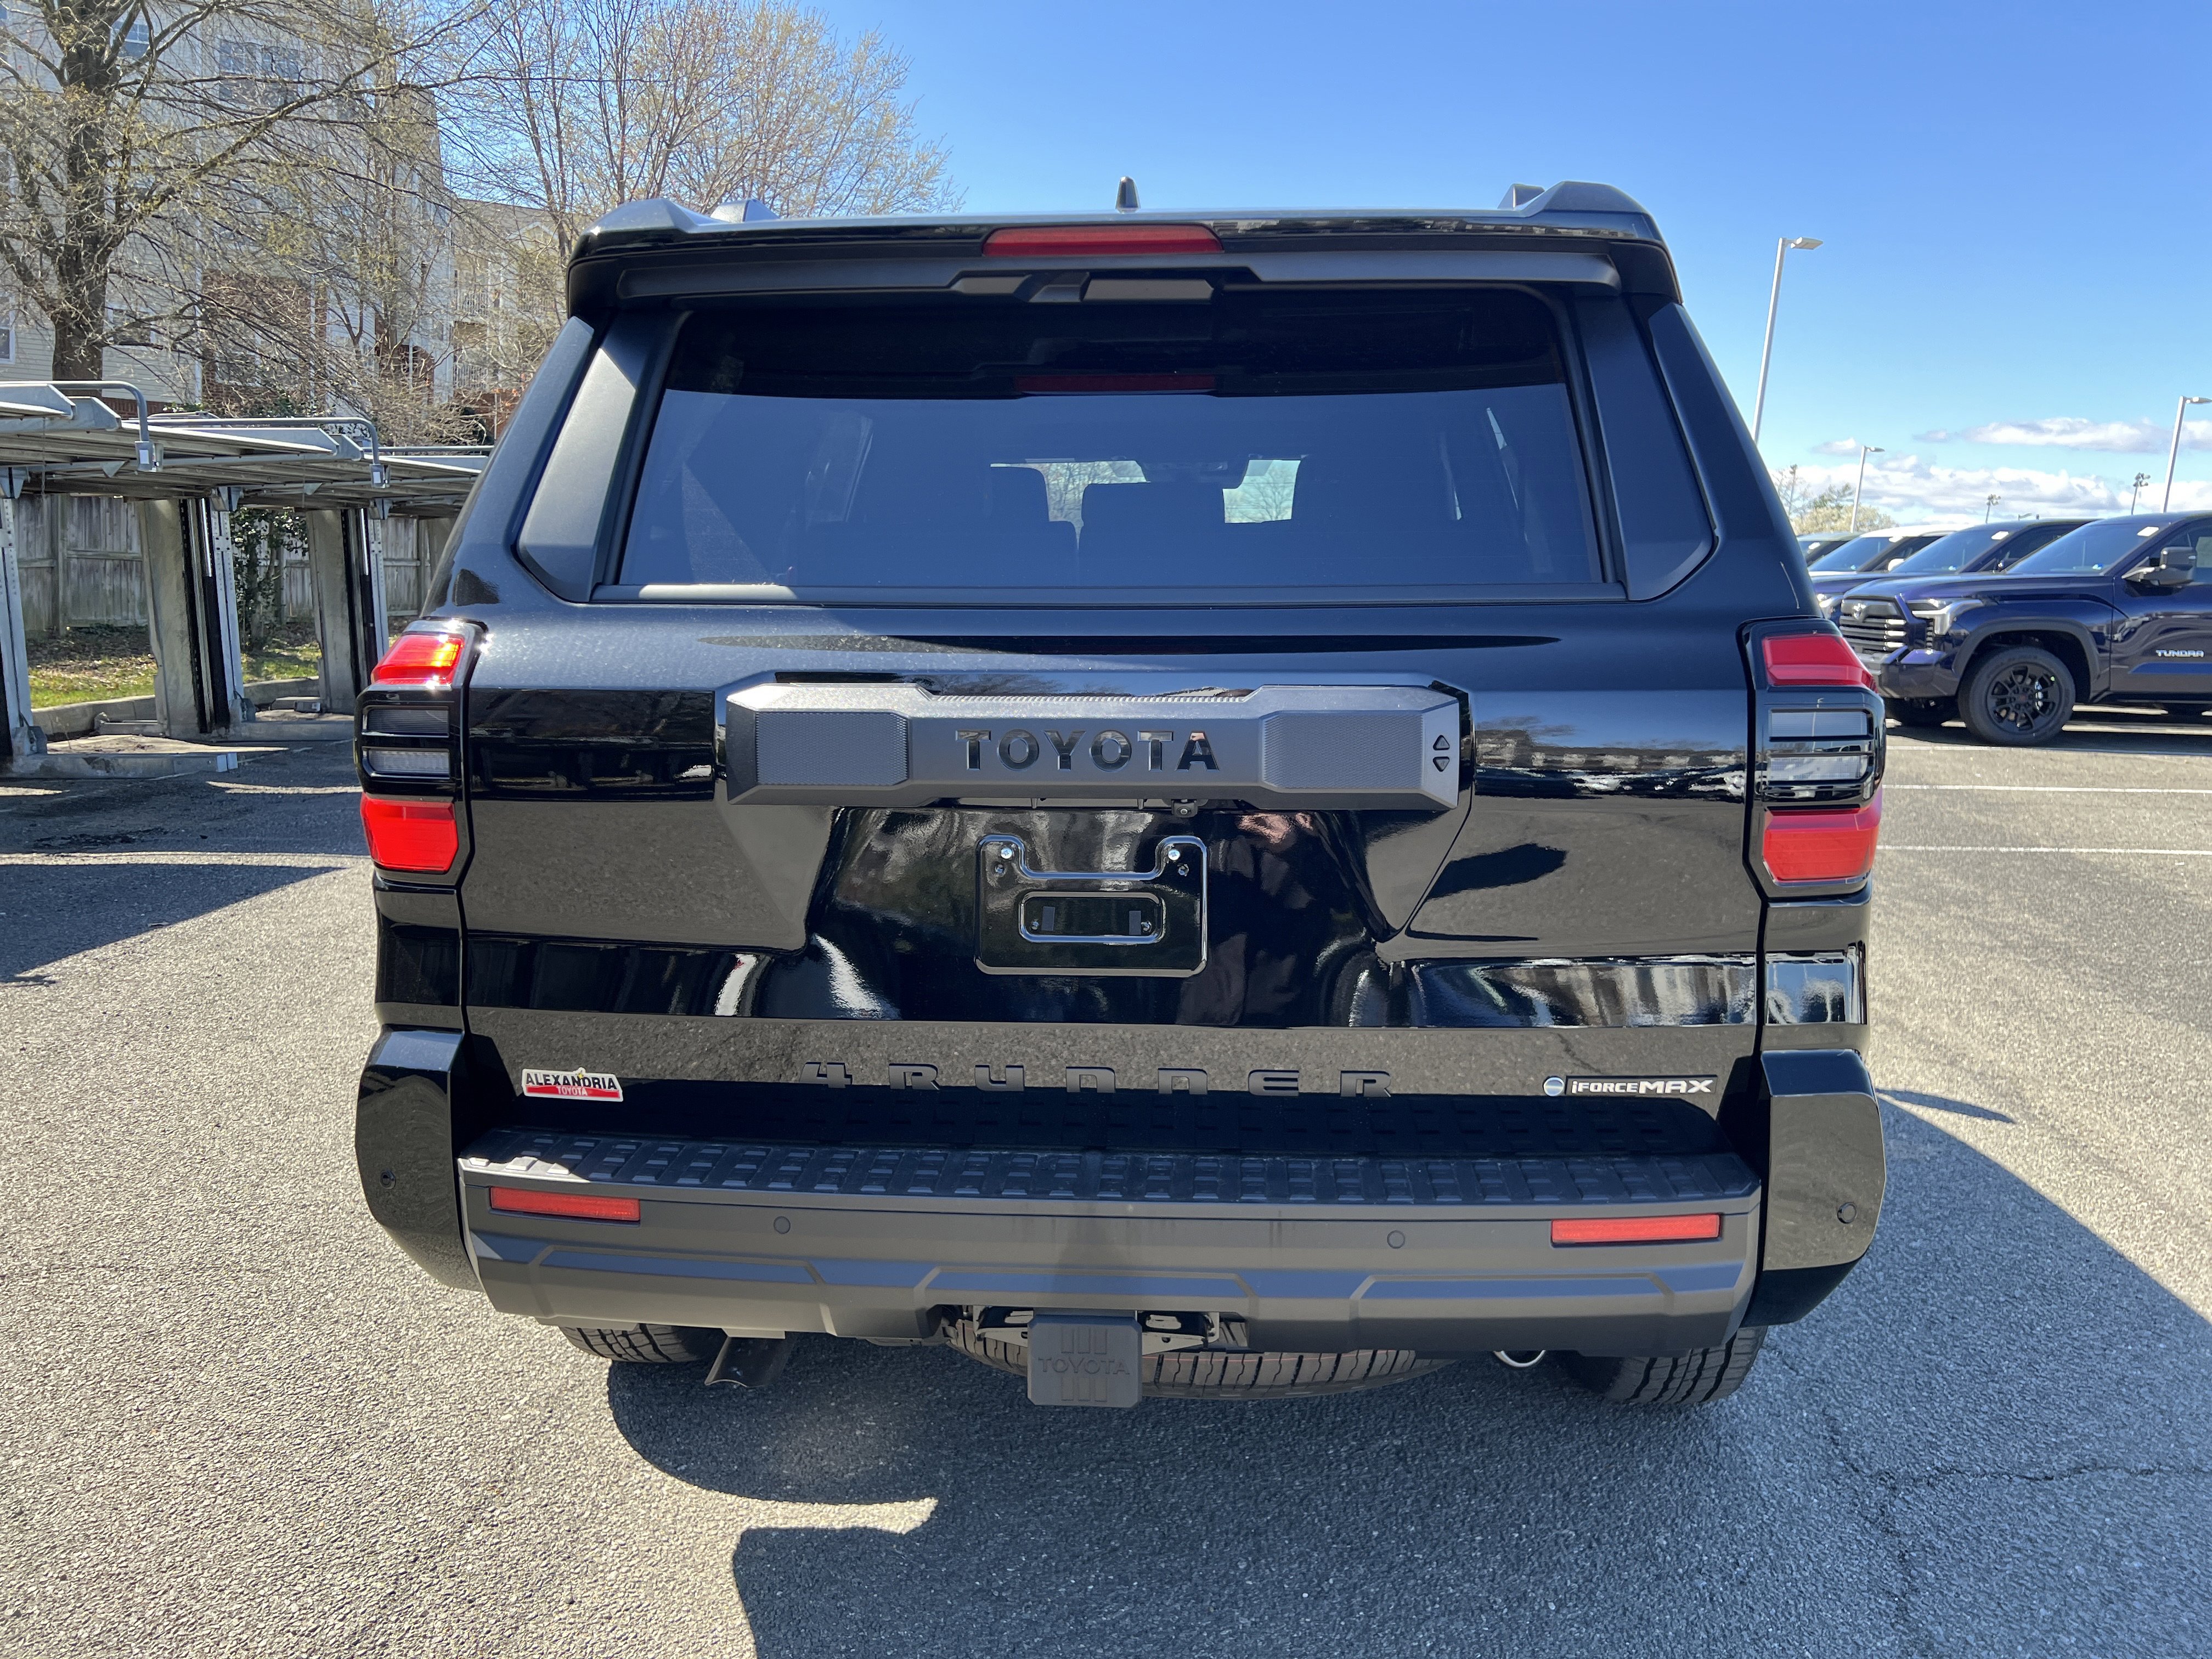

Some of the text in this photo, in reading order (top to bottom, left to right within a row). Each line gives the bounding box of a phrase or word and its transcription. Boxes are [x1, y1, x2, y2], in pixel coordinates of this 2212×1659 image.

[955, 729, 1220, 772] TOYOTA
[526, 1073, 618, 1090] ALEXANDRIA
[799, 1061, 1392, 1098] 4RUNNER
[556, 1085, 588, 1096] TOYOTA
[1038, 1357, 1130, 1375] TOYOTA
